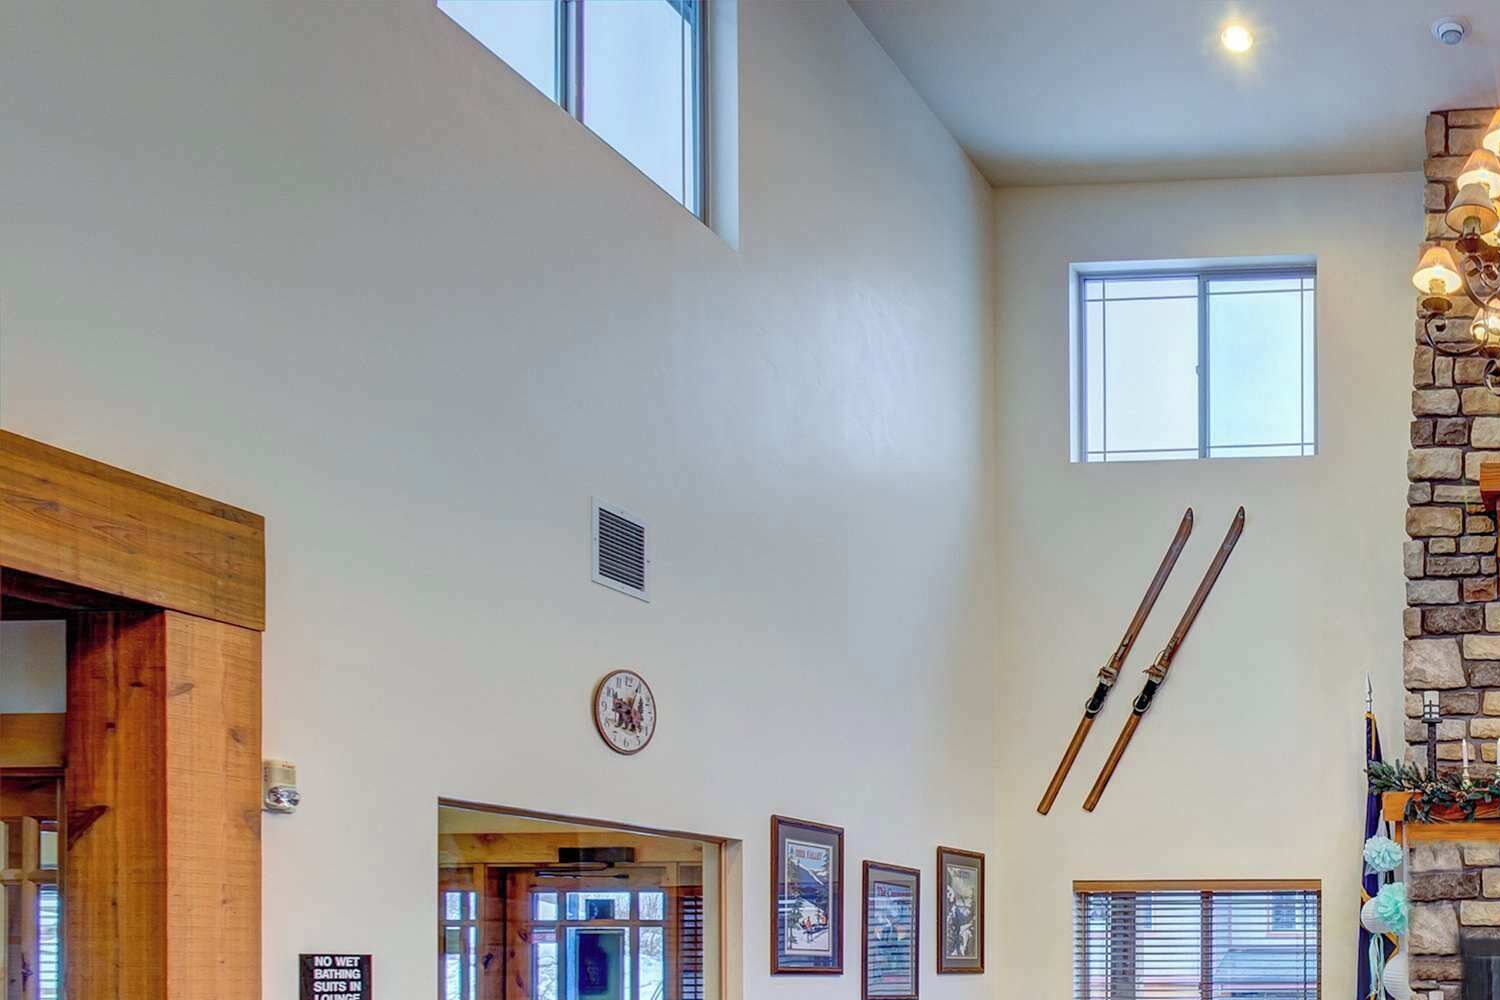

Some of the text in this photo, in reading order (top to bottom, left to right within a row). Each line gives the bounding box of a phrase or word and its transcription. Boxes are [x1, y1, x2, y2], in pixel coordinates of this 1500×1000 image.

[313, 956, 361, 967] NO WET
[313, 968, 362, 980] BATHING
[312, 981, 362, 992] SUITS IN
